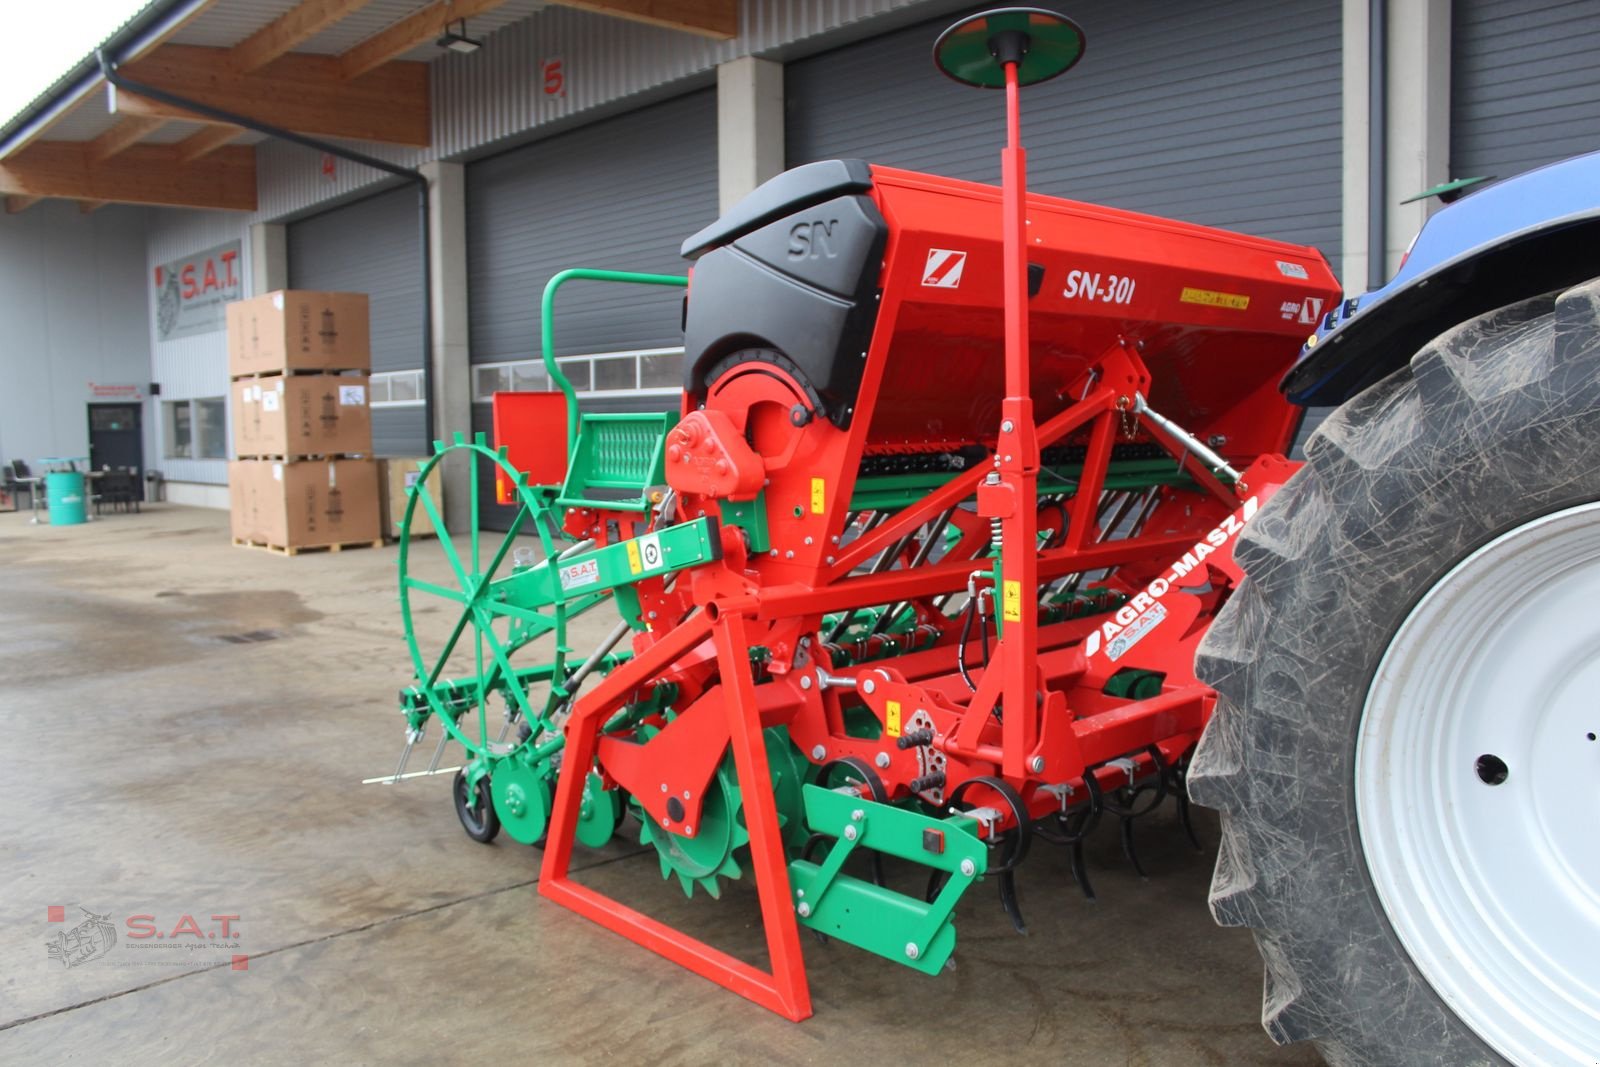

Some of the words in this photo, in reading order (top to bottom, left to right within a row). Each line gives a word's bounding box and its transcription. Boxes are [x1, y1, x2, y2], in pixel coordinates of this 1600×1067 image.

[543, 60, 564, 95] 5
[787, 219, 839, 262] SN
[1103, 514, 1244, 641] AGRO-MASZ
